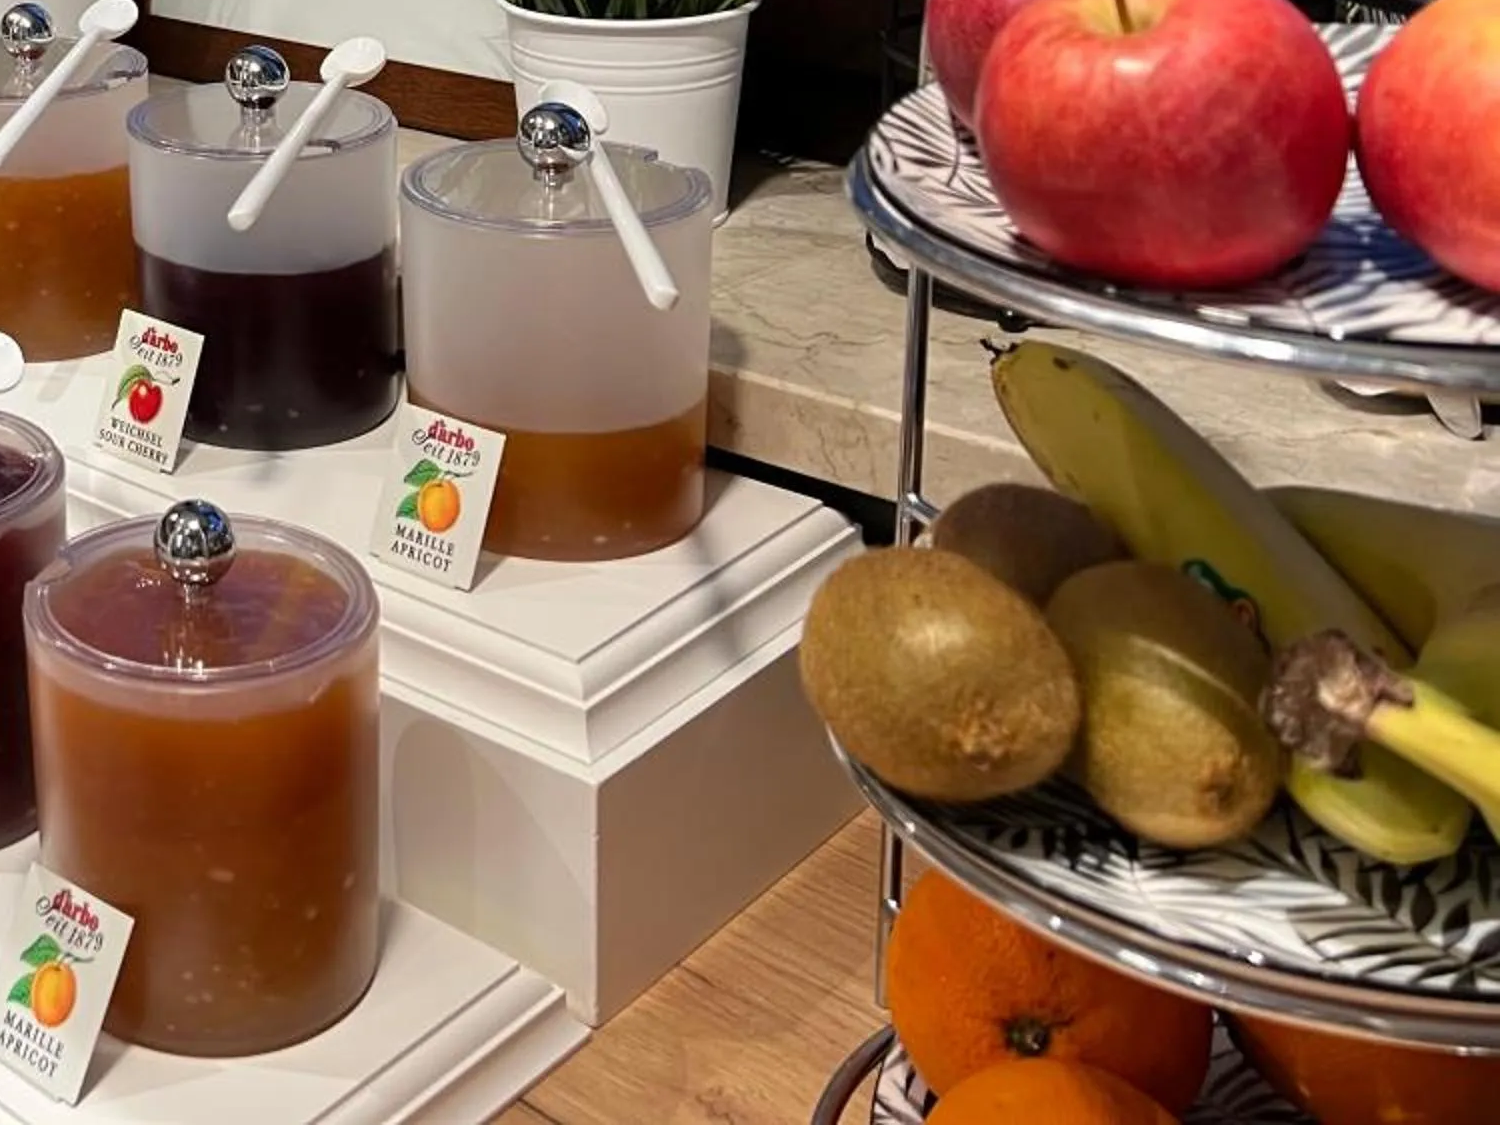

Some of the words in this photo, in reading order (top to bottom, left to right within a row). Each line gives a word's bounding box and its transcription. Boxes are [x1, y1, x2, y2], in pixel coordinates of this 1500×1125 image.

[99, 428, 125, 449] SOUR
[127, 439, 169, 466] CHERRY
[110, 416, 163, 449] WEICHSEL
[446, 450, 481, 468] 1879
[391, 540, 453, 573] APRICOT
[395, 523, 455, 558] MARILLE
[66, 926, 104, 952] 1879
[3, 1010, 65, 1060] MARILLE
